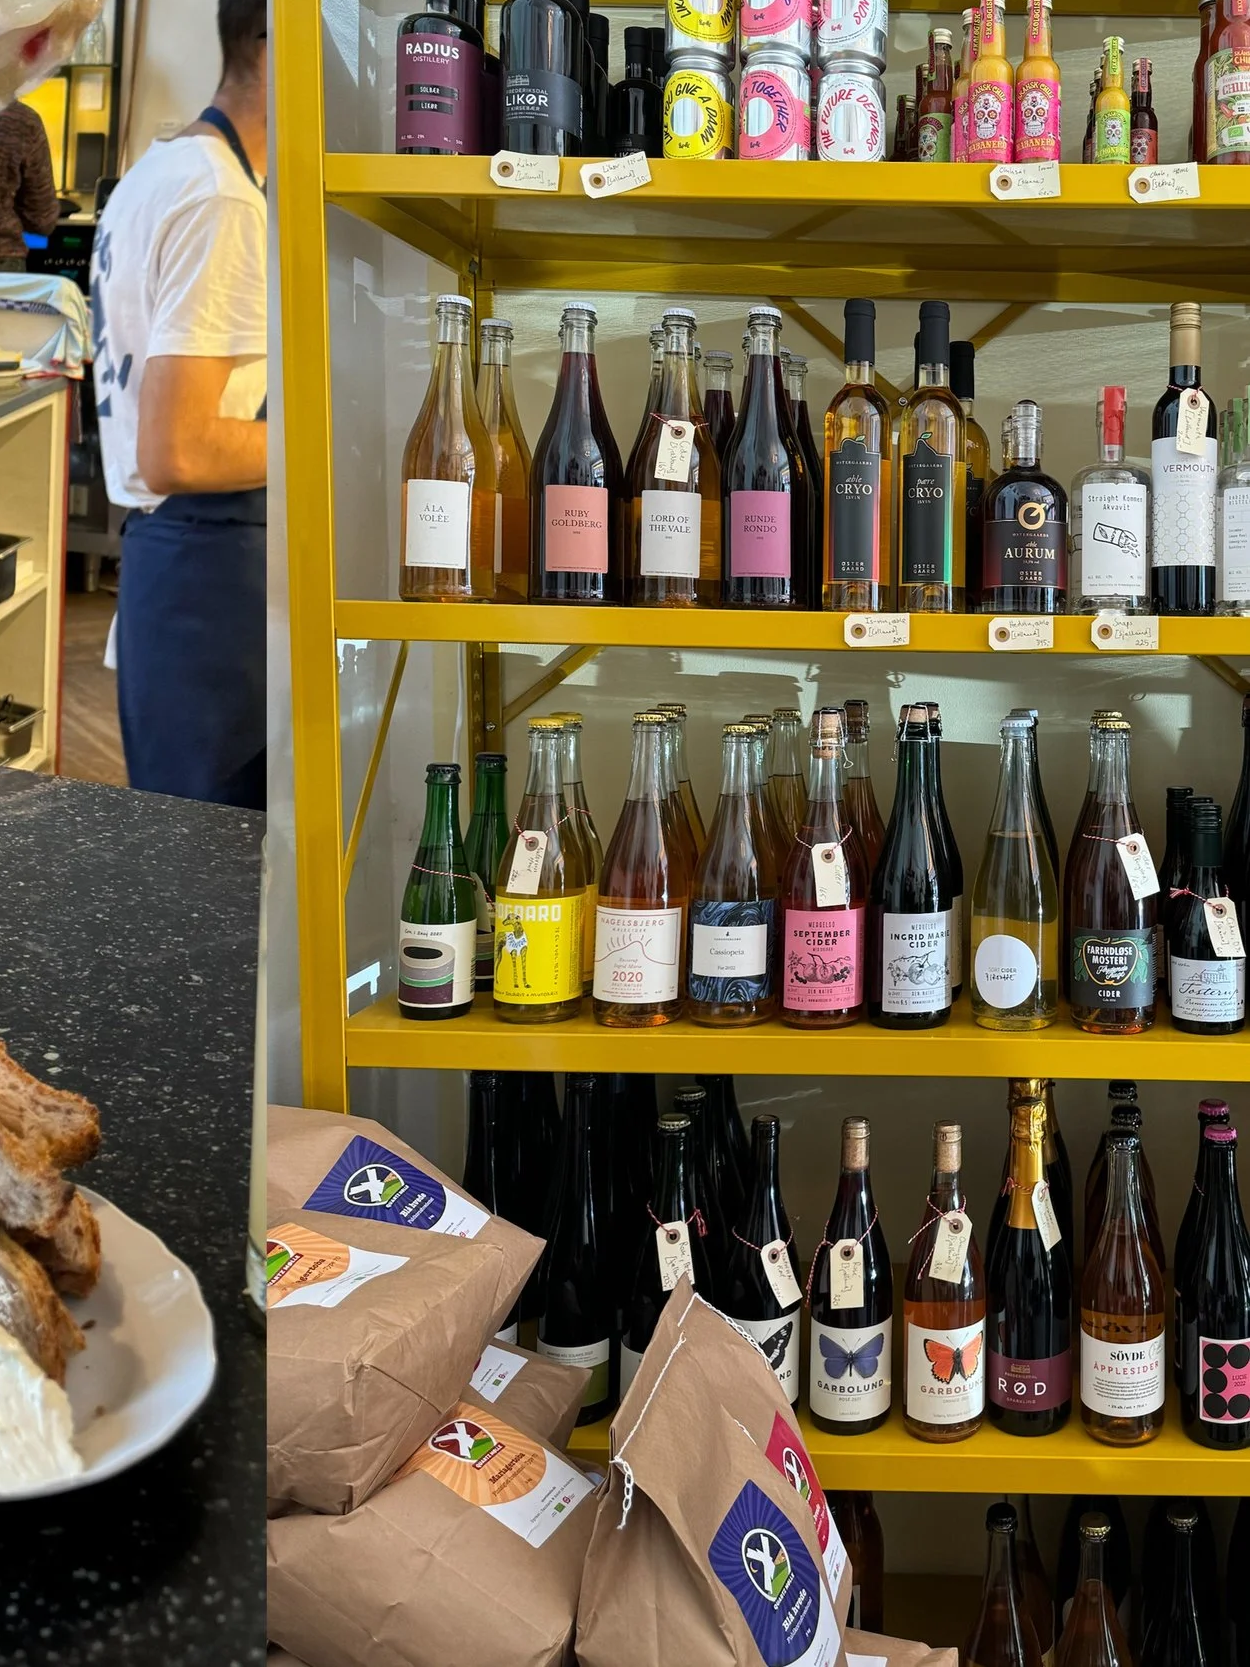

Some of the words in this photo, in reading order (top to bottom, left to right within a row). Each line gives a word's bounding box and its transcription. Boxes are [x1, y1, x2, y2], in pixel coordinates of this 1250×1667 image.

[405, 42, 460, 60] RADIUS
[413, 55, 450, 64] DISTILLERY
[420, 86, 440, 94] SOLBÆR
[675, 83, 703, 97] GIVE
[506, 94, 548, 107] LIKØR
[699, 95, 712, 104] A
[420, 102, 438, 110] LIKØR
[751, 81, 789, 134] TOGETHER
[821, 88, 855, 126] FUTURE
[702, 106, 718, 146] DAMN
[855, 94, 880, 153] DEPENDS
[820, 128, 836, 150] THE
[1163, 464, 1215, 473] VERMOUTH
[835, 484, 873, 495] CRYO
[908, 487, 943, 498] CRYO
[1088, 495, 1119, 503] Straight
[563, 509, 590, 519] RUBY
[650, 514, 676, 522] LORD
[677, 515, 690, 523] OF
[744, 514, 777, 524] RUNDE
[551, 518, 603, 529] GOLDBERG
[649, 524, 667, 532] THE
[668, 525, 691, 533] VALE
[743, 525, 778, 534] RONDO
[1004, 548, 1055, 560] AURUM
[601, 917, 665, 927] NAGELSBJERG
[927, 930, 950, 940] MARIE
[909, 940, 938, 948] CIDER
[709, 948, 744, 957] Cassiopeia
[1087, 945, 1133, 956] FARENDLØSE
[1092, 956, 1128, 965] MOSTERI
[612, 971, 643, 982] 2020
[1098, 990, 1121, 998] CIDER
[400, 1204, 413, 1218] Blå
[268, 1269, 285, 1287] UARTZ
[284, 1253, 301, 1271] MØLLE
[1110, 1350, 1146, 1361] SÖVDE
[817, 1379, 884, 1393] GARBOLUND
[998, 1377, 1047, 1396] RØD
[475, 1454, 491, 1468] QUARTZ
[489, 1452, 526, 1485] Mariagertoba
[773, 1590, 786, 1610] QUARTZ
[785, 1572, 796, 1592] MØLLE
[781, 1611, 796, 1632] Blå
[792, 1588, 807, 1614] hvede
